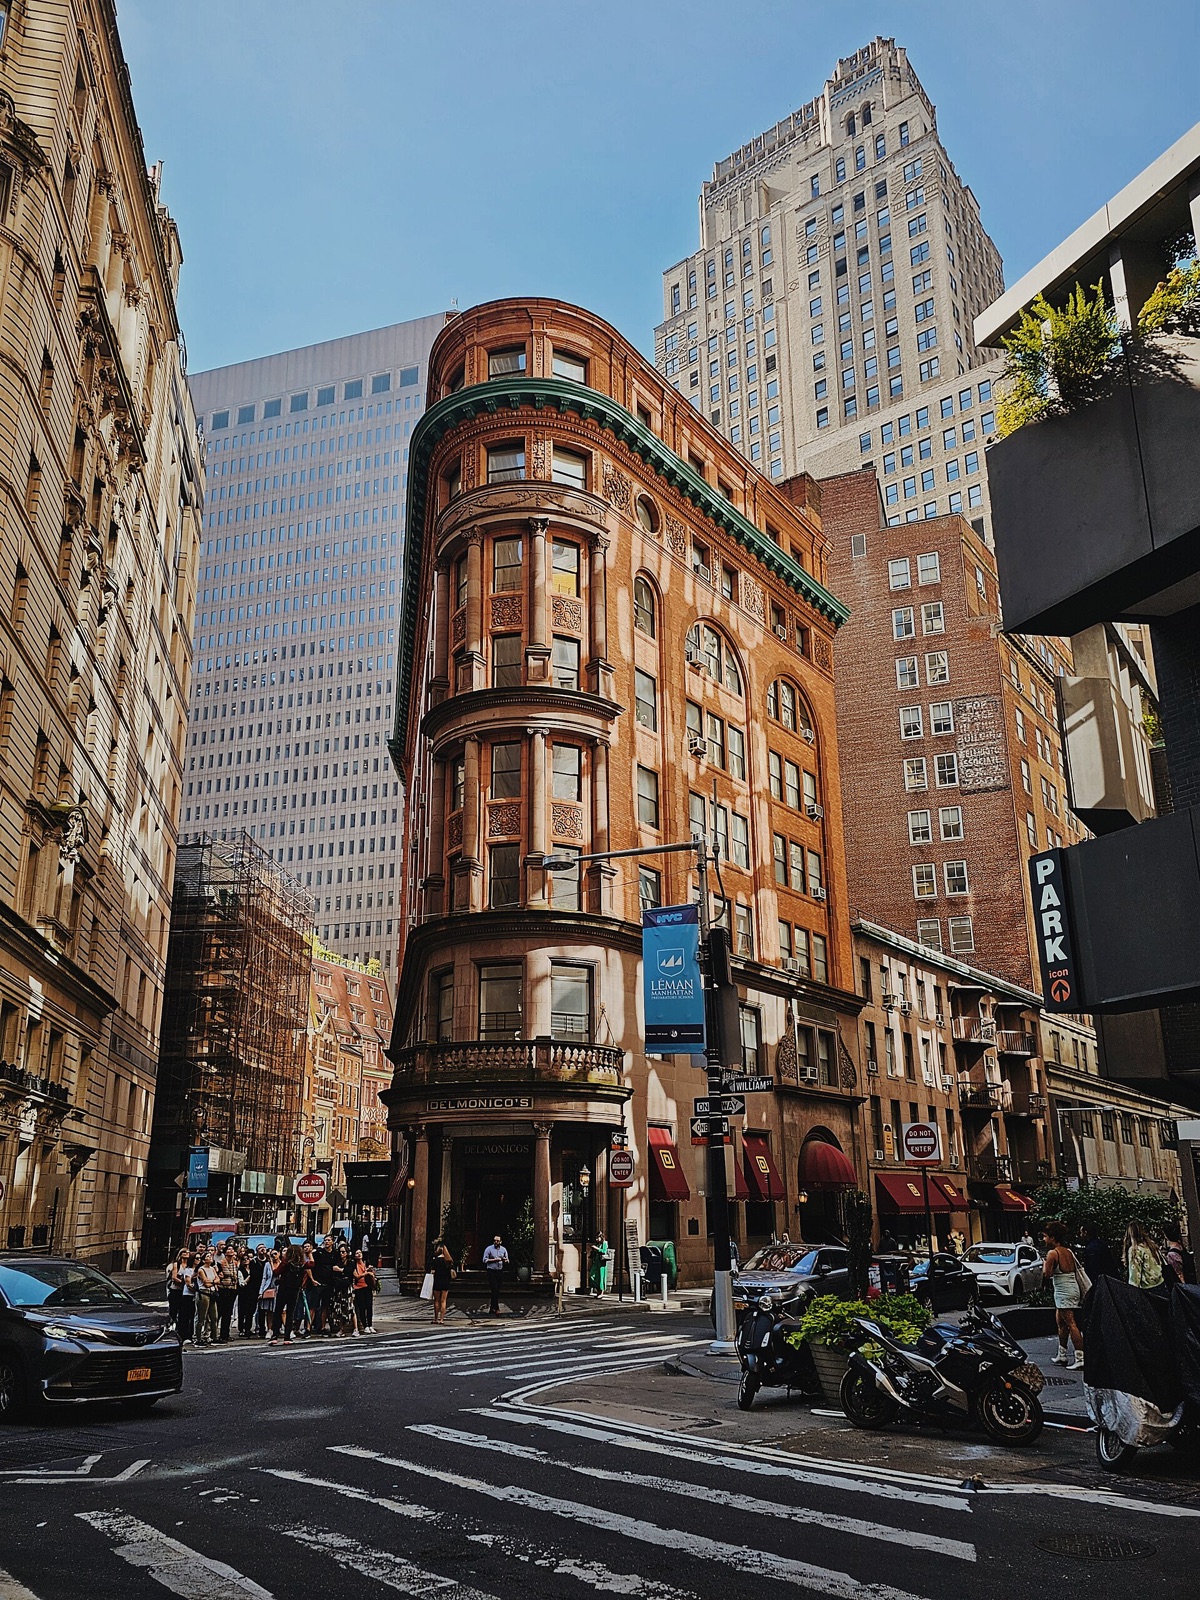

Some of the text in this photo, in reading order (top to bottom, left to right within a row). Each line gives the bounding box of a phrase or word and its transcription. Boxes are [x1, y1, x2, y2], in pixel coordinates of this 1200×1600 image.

[1035, 858, 1068, 963] PARK
[657, 913, 682, 923] NYC
[1049, 968, 1069, 979] icon
[651, 979, 693, 990] LÉMAN
[736, 1081, 766, 1091] WILLIAM
[430, 1098, 529, 1110] DELMONICO'S
[698, 1101, 738, 1112] ON WAY
